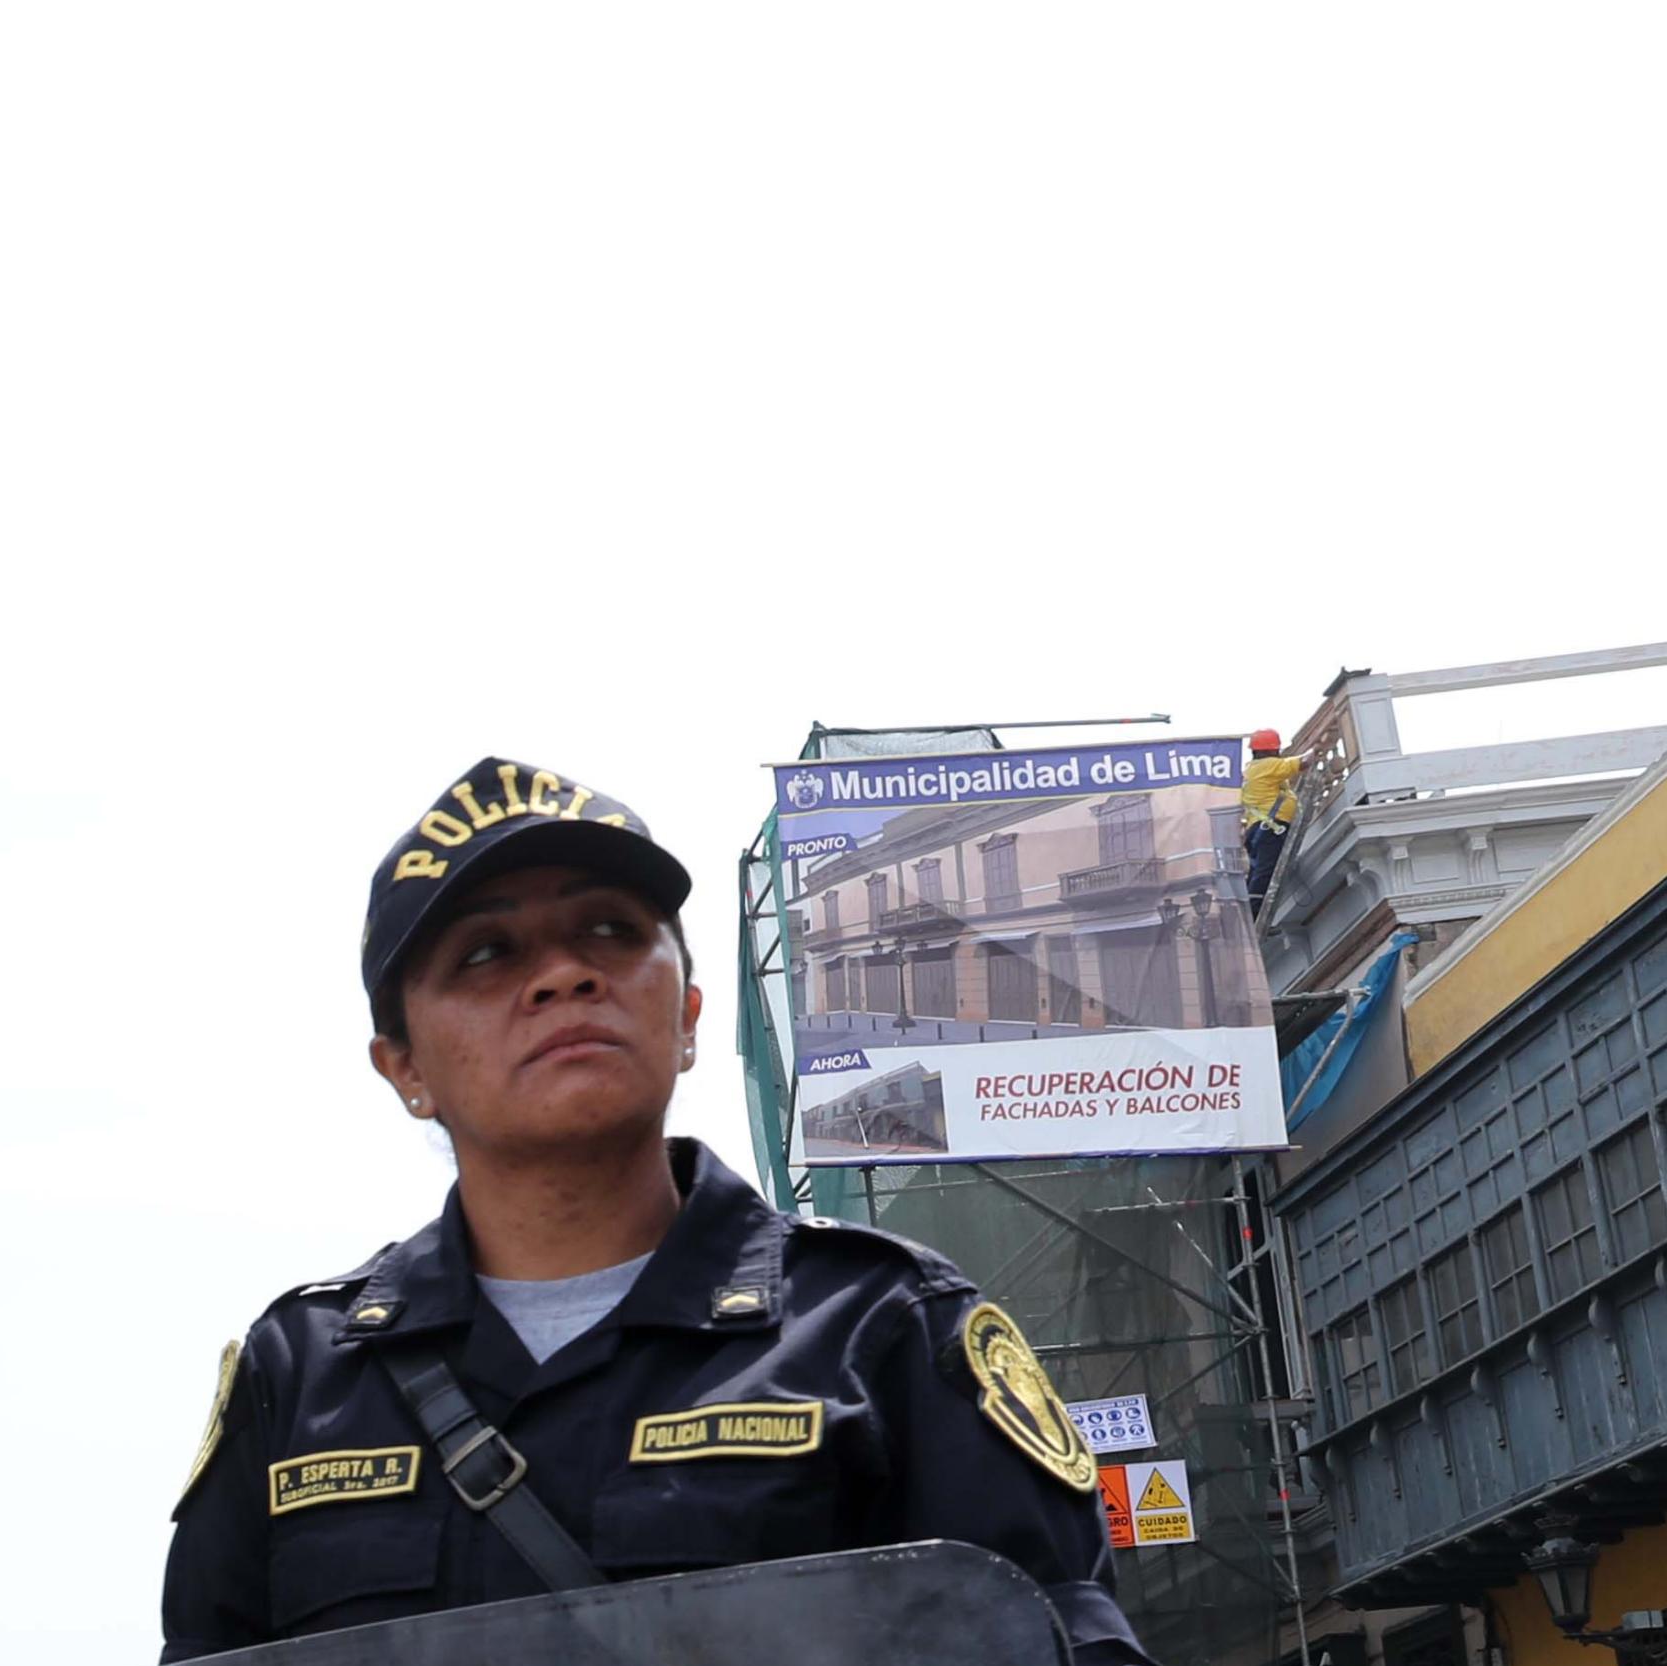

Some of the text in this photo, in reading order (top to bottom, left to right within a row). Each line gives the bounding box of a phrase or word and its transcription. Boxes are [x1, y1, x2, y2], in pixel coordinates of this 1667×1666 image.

[830, 750, 1231, 801] Municipalidad de Lima
[787, 836, 847, 857] PRONTO
[810, 1052, 861, 1071] AHORA
[975, 1061, 1241, 1099] RECUPERACIÓN DE
[980, 1091, 1241, 1121] FACHADAS Y BALCONES
[644, 1416, 808, 1448] POLICIA NACIONAL
[301, 1459, 374, 1484] ESPERTA
[1138, 1515, 1187, 1527] CUIDADO
